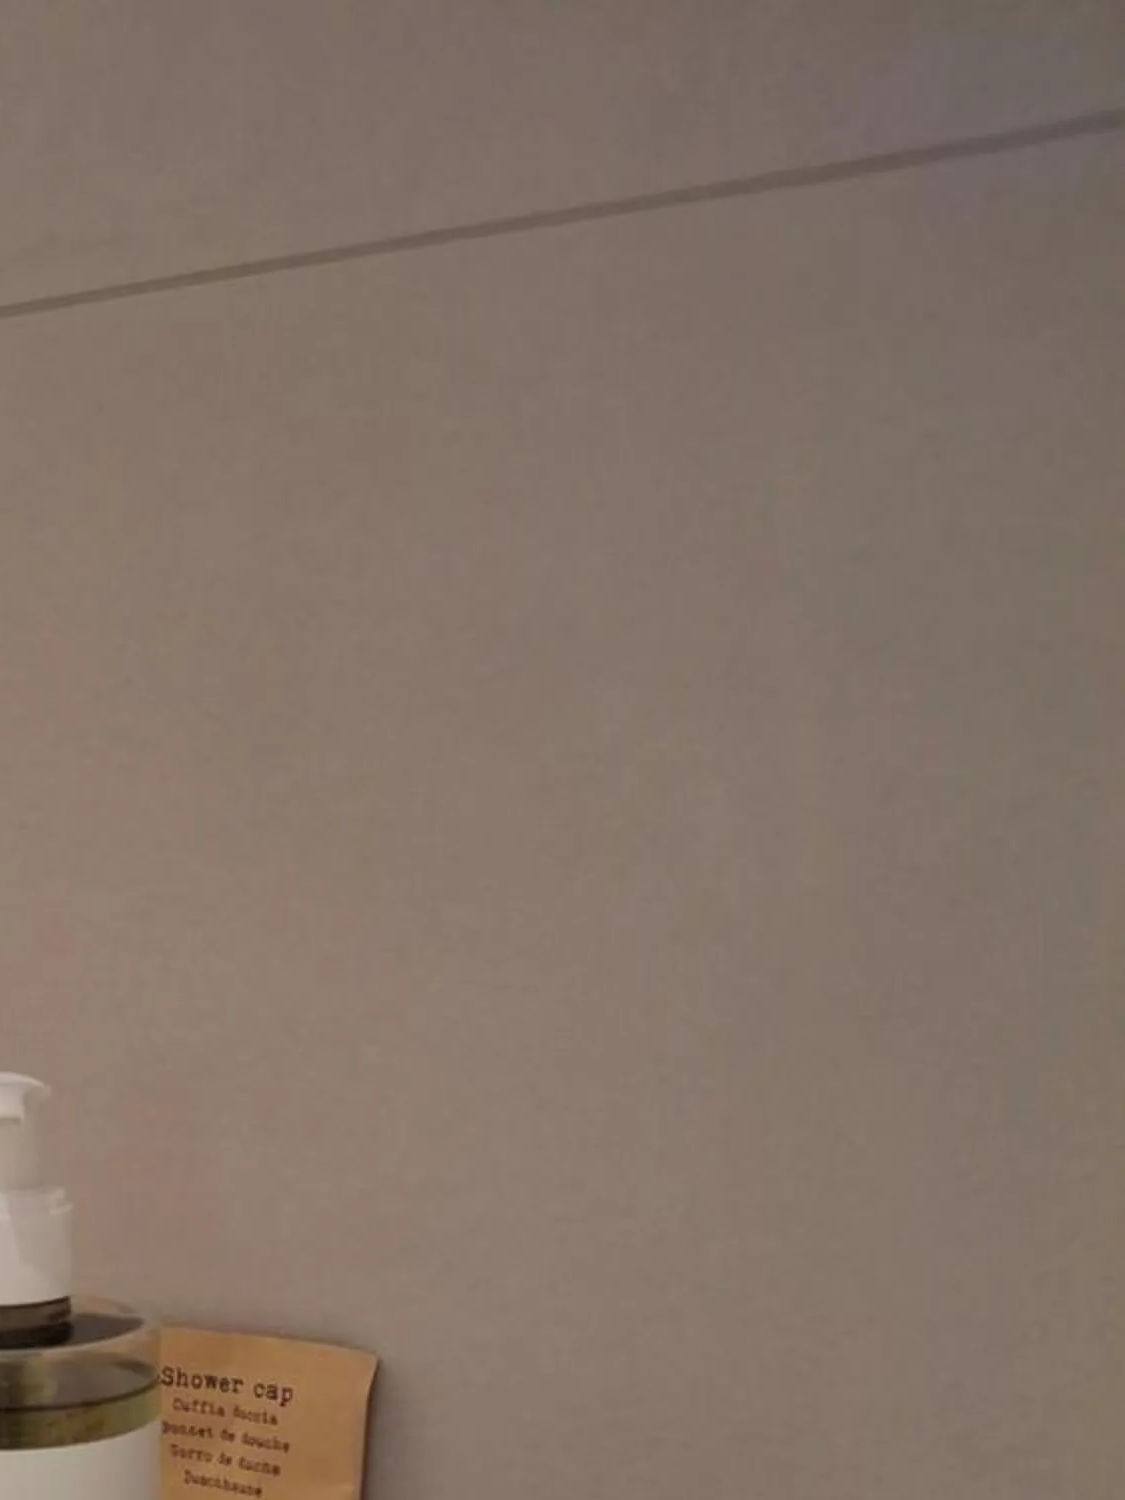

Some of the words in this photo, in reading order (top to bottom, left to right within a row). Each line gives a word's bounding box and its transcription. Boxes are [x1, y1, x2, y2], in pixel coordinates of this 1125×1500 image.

[160, 1365, 244, 1394] Shower
[253, 1381, 295, 1407] cap
[172, 1397, 225, 1417] Cuffia
